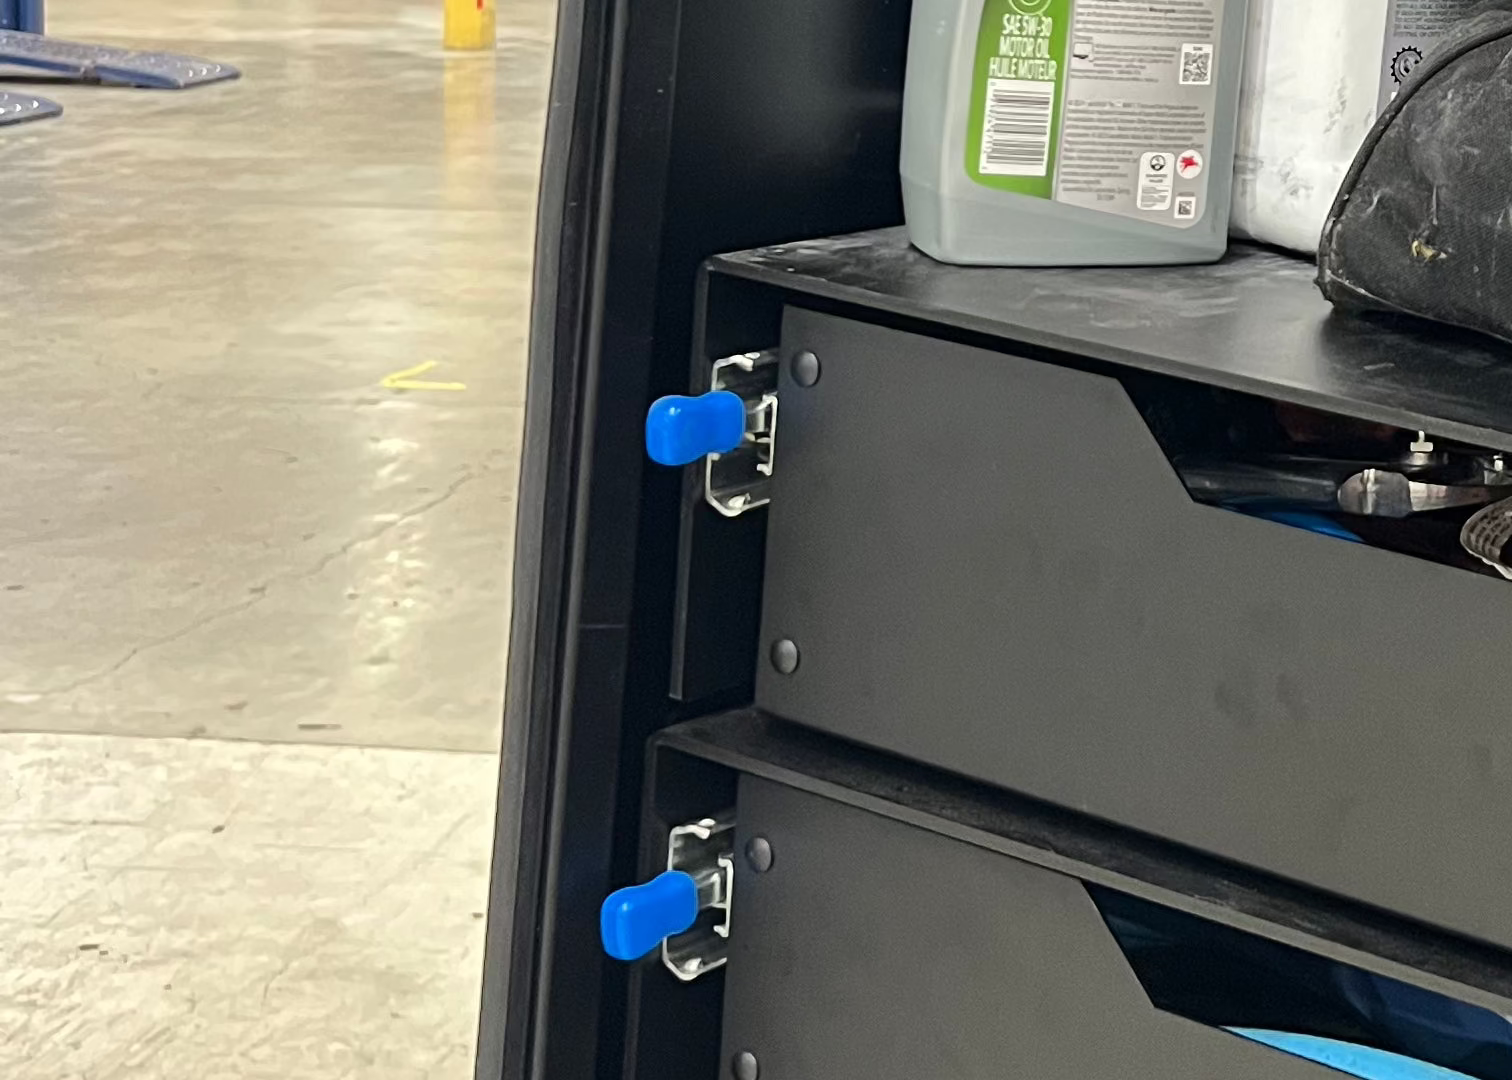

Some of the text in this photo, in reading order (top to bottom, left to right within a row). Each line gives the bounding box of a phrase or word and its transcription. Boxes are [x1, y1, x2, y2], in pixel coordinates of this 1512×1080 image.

[999, 35, 1050, 59] MOTOR OIL
[989, 57, 1017, 78] HUILE
[1018, 59, 1057, 80] MOTEUR
